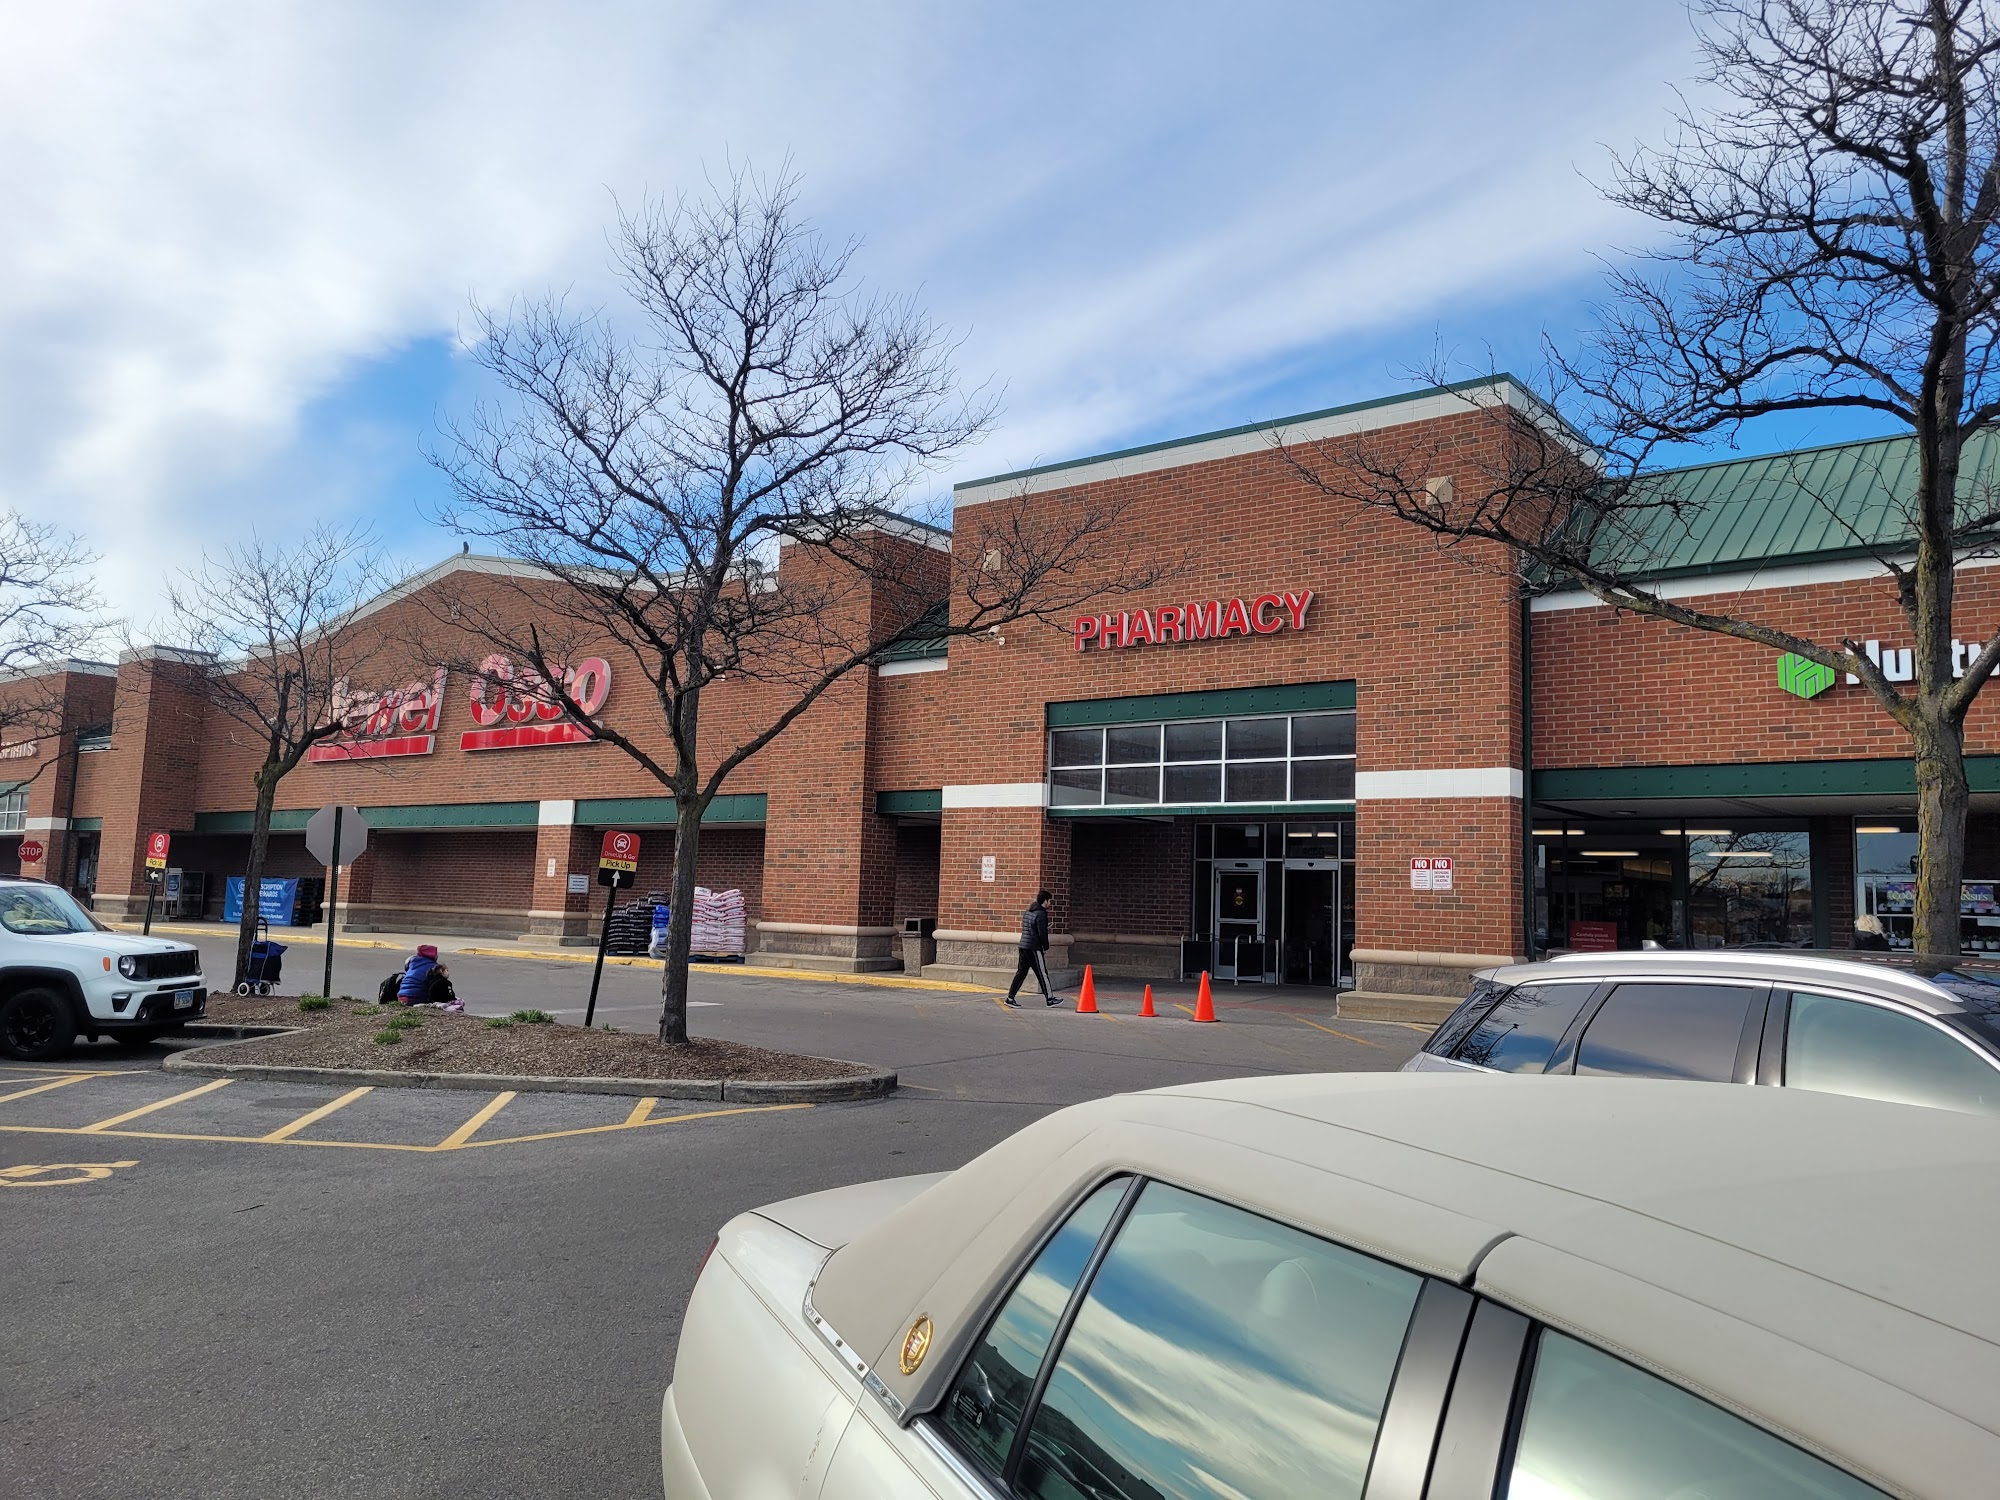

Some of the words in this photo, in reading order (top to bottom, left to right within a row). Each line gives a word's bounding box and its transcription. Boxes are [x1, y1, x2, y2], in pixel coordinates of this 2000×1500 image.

[1074, 589, 1315, 652] PHARMACY
[311, 662, 448, 742] Jewel
[470, 653, 611, 726] Osco
[20, 847, 42, 856] STOP
[621, 862, 630, 870] Up
[1415, 860, 1427, 868] NO
[1435, 860, 1447, 868] NO
